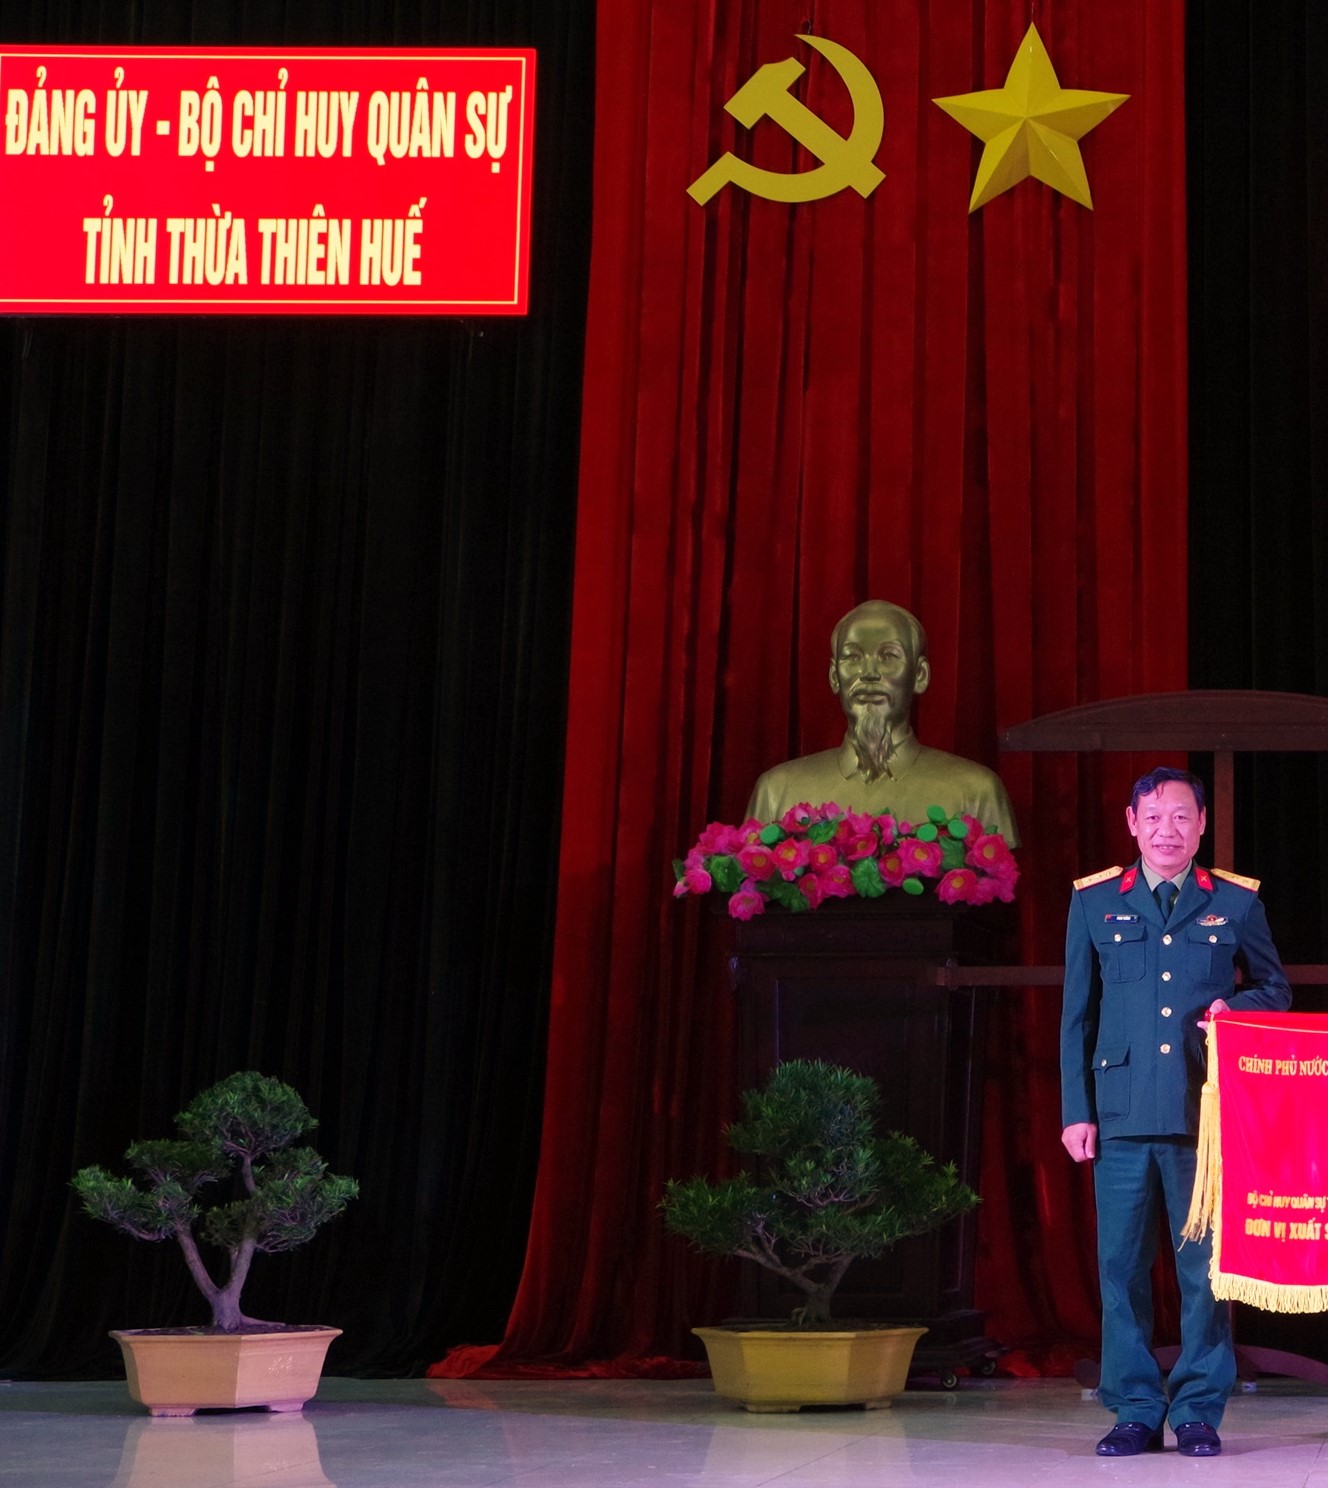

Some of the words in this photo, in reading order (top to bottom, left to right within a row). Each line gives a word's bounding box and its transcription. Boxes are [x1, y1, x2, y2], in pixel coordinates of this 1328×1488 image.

[5, 66, 97, 156] ĐẢNG
[105, 66, 148, 156] ỦY
[156, 120, 171, 136] -
[178, 76, 223, 172] BỘ
[231, 67, 289, 158] CHỈ
[294, 91, 360, 158] HUY
[367, 77, 456, 166] QUÂN
[464, 85, 513, 174] SỰ
[83, 194, 158, 285] TỈNH
[166, 203, 248, 285] THỪA
[258, 203, 352, 286] THIÊN
[359, 196, 428, 286] HUẾ
[1238, 1054, 1273, 1075] CHÍNH
[1275, 1054, 1298, 1076] PHỦ
[1245, 1218, 1271, 1238] ĐƠN
[1273, 1221, 1287, 1242] VỊ
[1289, 1217, 1322, 1241] XUẤT
